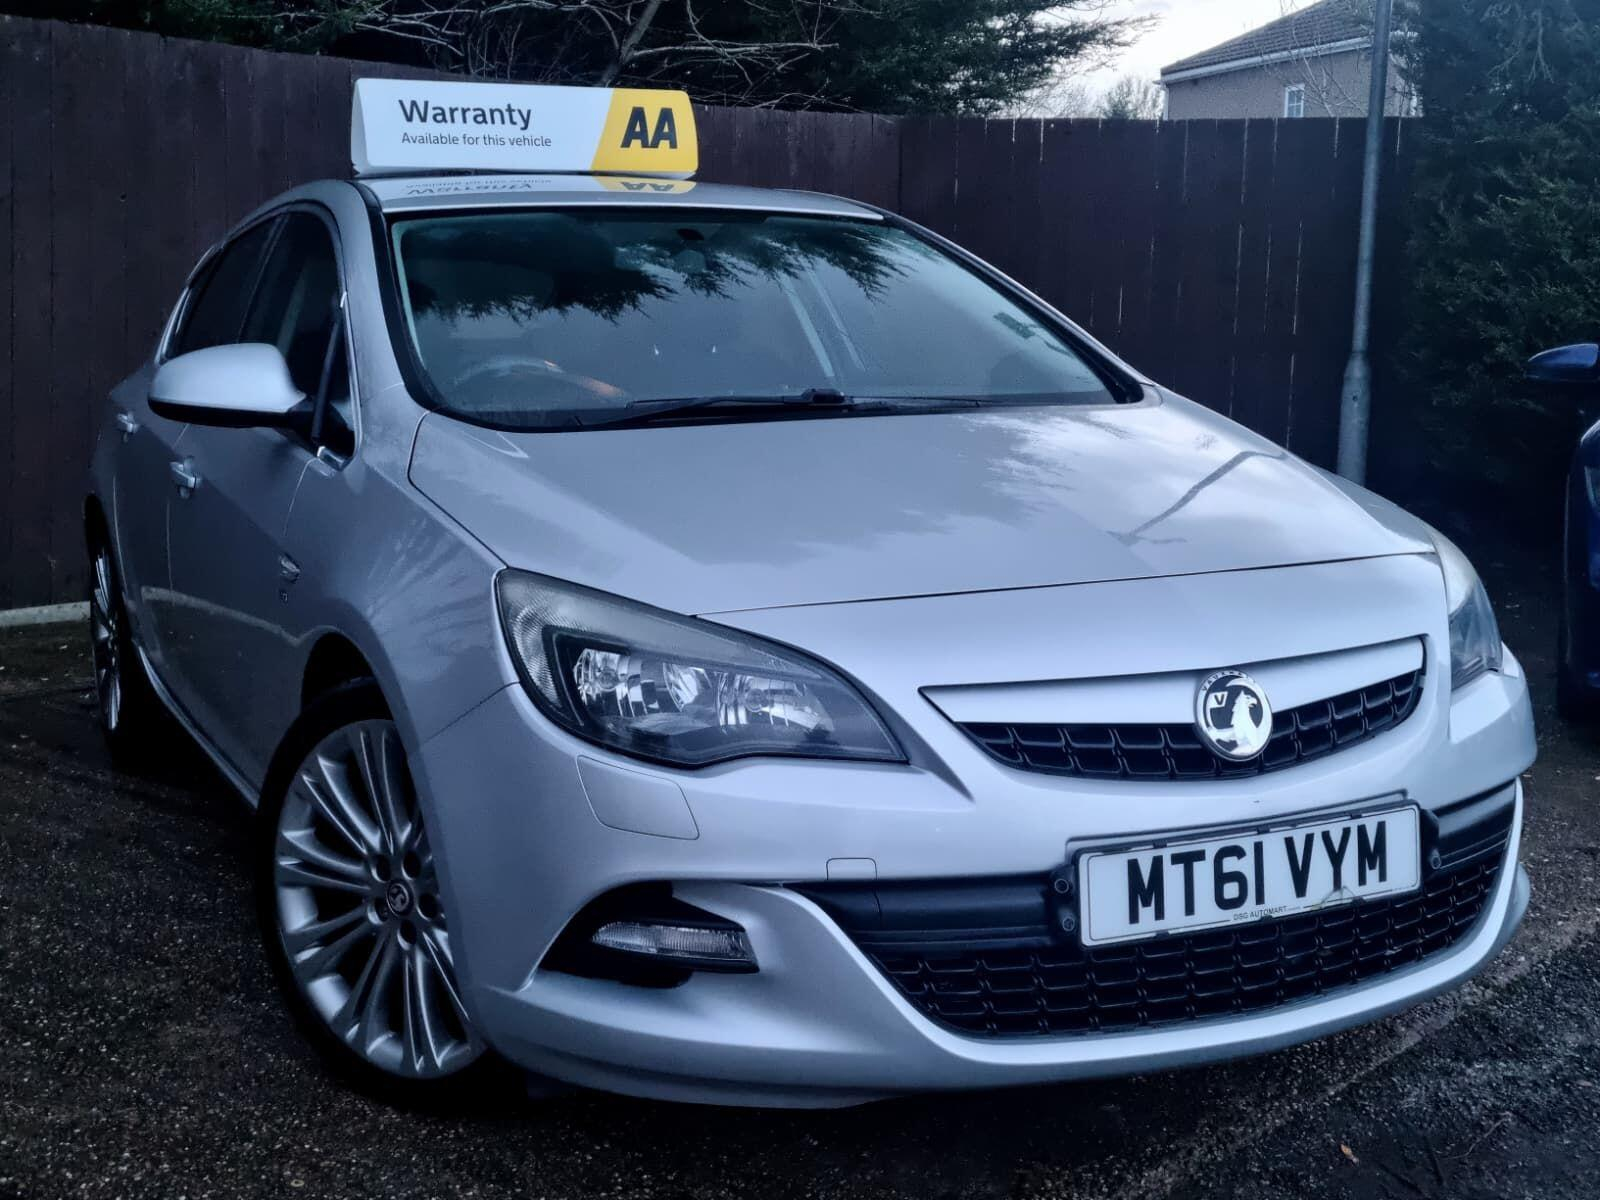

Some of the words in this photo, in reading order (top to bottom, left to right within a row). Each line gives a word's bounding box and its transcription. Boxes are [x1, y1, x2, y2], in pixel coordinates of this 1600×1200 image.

[398, 98, 532, 131] Warranty
[401, 132, 459, 145] Available
[462, 133, 480, 146] for
[483, 134, 506, 146] this
[508, 134, 552, 147] vehicle
[620, 106, 678, 149] AA
[1214, 693, 1225, 706] V
[1127, 840, 1266, 925] MT61
[1284, 820, 1388, 899] VYM
[1233, 911, 1249, 921] DSG
[1249, 905, 1288, 919] AUTOMART
